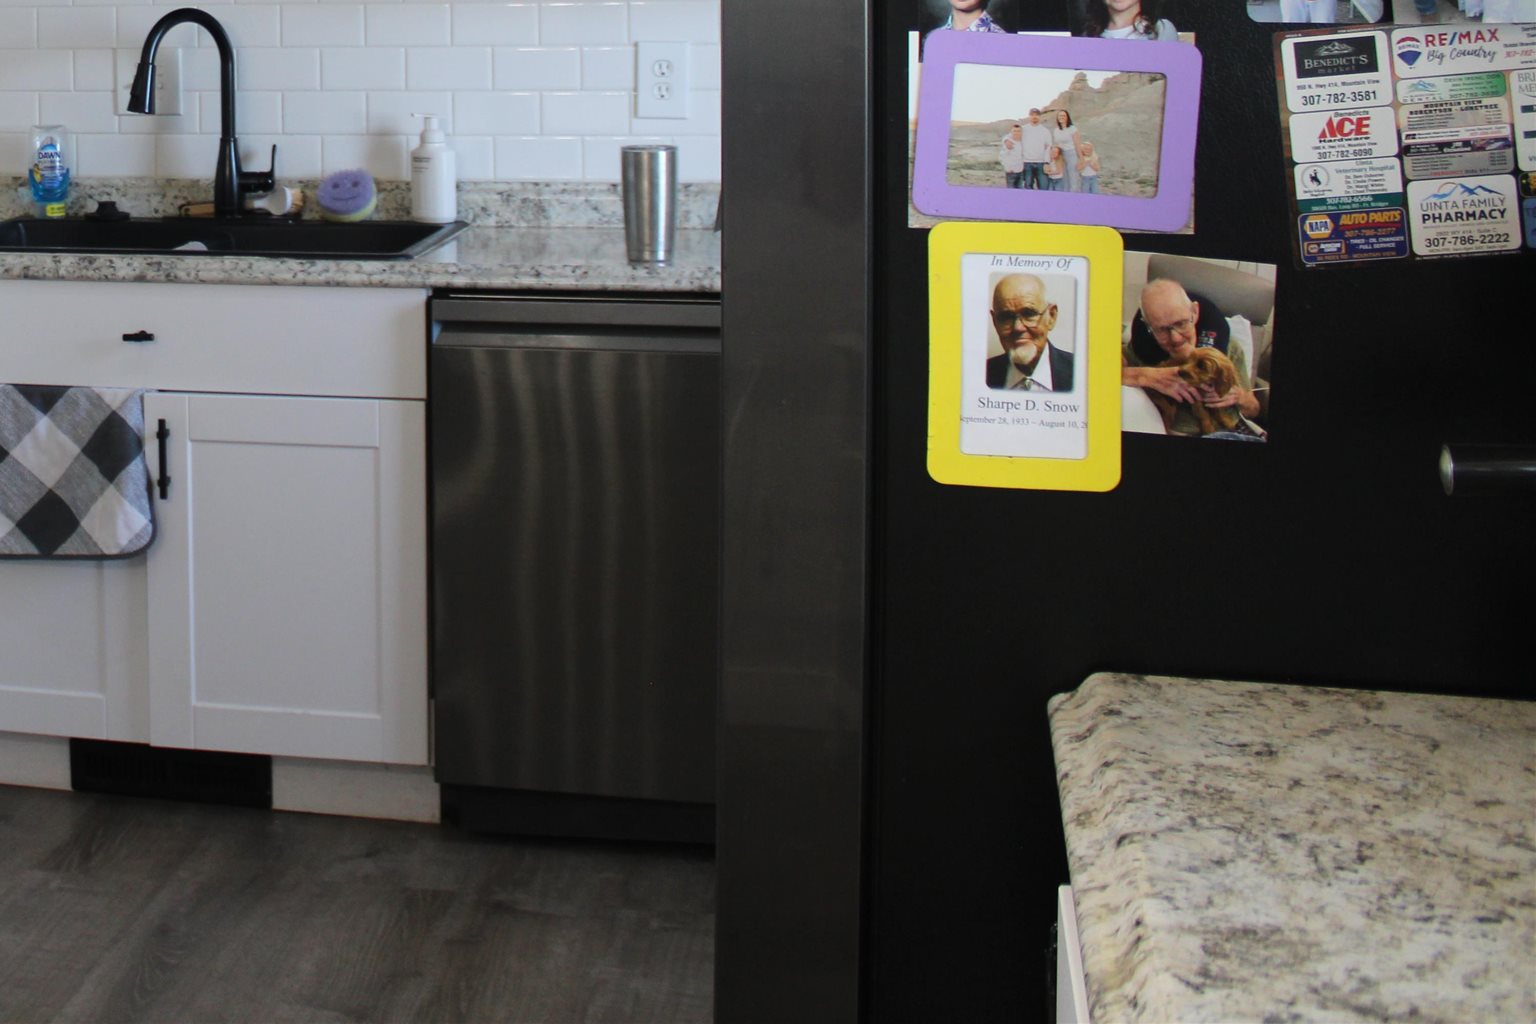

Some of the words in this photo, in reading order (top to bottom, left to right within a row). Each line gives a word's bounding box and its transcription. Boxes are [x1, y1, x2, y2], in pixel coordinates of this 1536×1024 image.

[1424, 28, 1500, 47] RE/MAX
[1426, 48, 1445, 65] Big
[1449, 46, 1498, 63] Country
[1302, 90, 1377, 106] 307-782-3581
[1318, 116, 1371, 139] ACE
[38, 151, 62, 160] DAWN
[1317, 148, 1373, 159] 307-782-6090
[1420, 201, 1459, 212] UINTA
[1462, 197, 1506, 208] FAMILY
[1340, 213, 1367, 225] AUTO
[1369, 210, 1401, 222] PARTS
[1422, 208, 1507, 224] PHARMACY
[1308, 220, 1330, 232] NAPA
[1424, 233, 1510, 248] 307-786-2222
[991, 255, 1003, 266] In
[1006, 256, 1053, 271] Memory
[1056, 257, 1073, 271] Of
[977, 396, 1021, 413] Sharpe
[1025, 399, 1039, 411] D.
[1043, 400, 1080, 413] Snow
[1038, 420, 1065, 429] August
